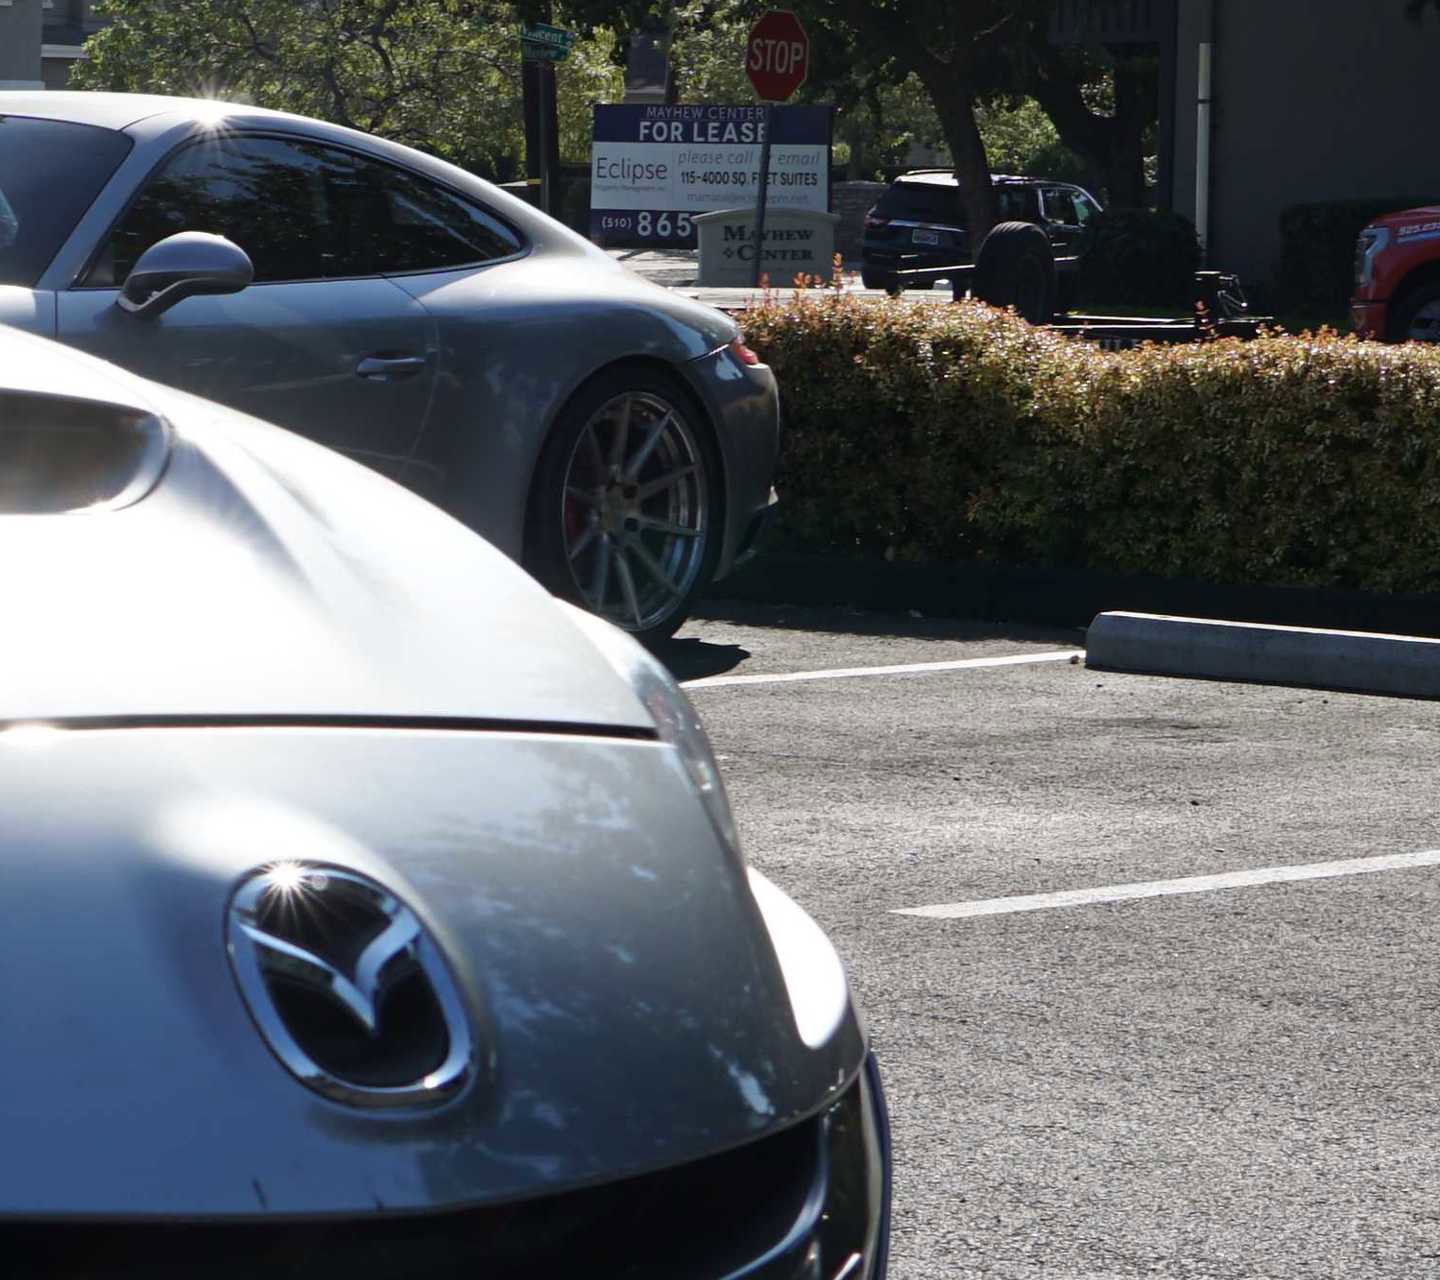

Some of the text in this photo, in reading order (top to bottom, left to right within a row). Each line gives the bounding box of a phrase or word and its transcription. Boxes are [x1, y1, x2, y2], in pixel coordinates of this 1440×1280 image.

[751, 38, 804, 74] STOP
[646, 106, 765, 119] MAYHEW CENTER
[639, 121, 767, 143] FOR LEASE
[677, 149, 721, 166] please
[727, 150, 754, 164] call
[777, 150, 821, 165] email
[596, 156, 668, 185] Eclipse
[681, 170, 730, 185] 115-4000
[751, 171, 778, 185] FET
[780, 172, 818, 187] SUITES
[601, 211, 692, 237] (510) 865
[736, 244, 814, 261] CENTER
